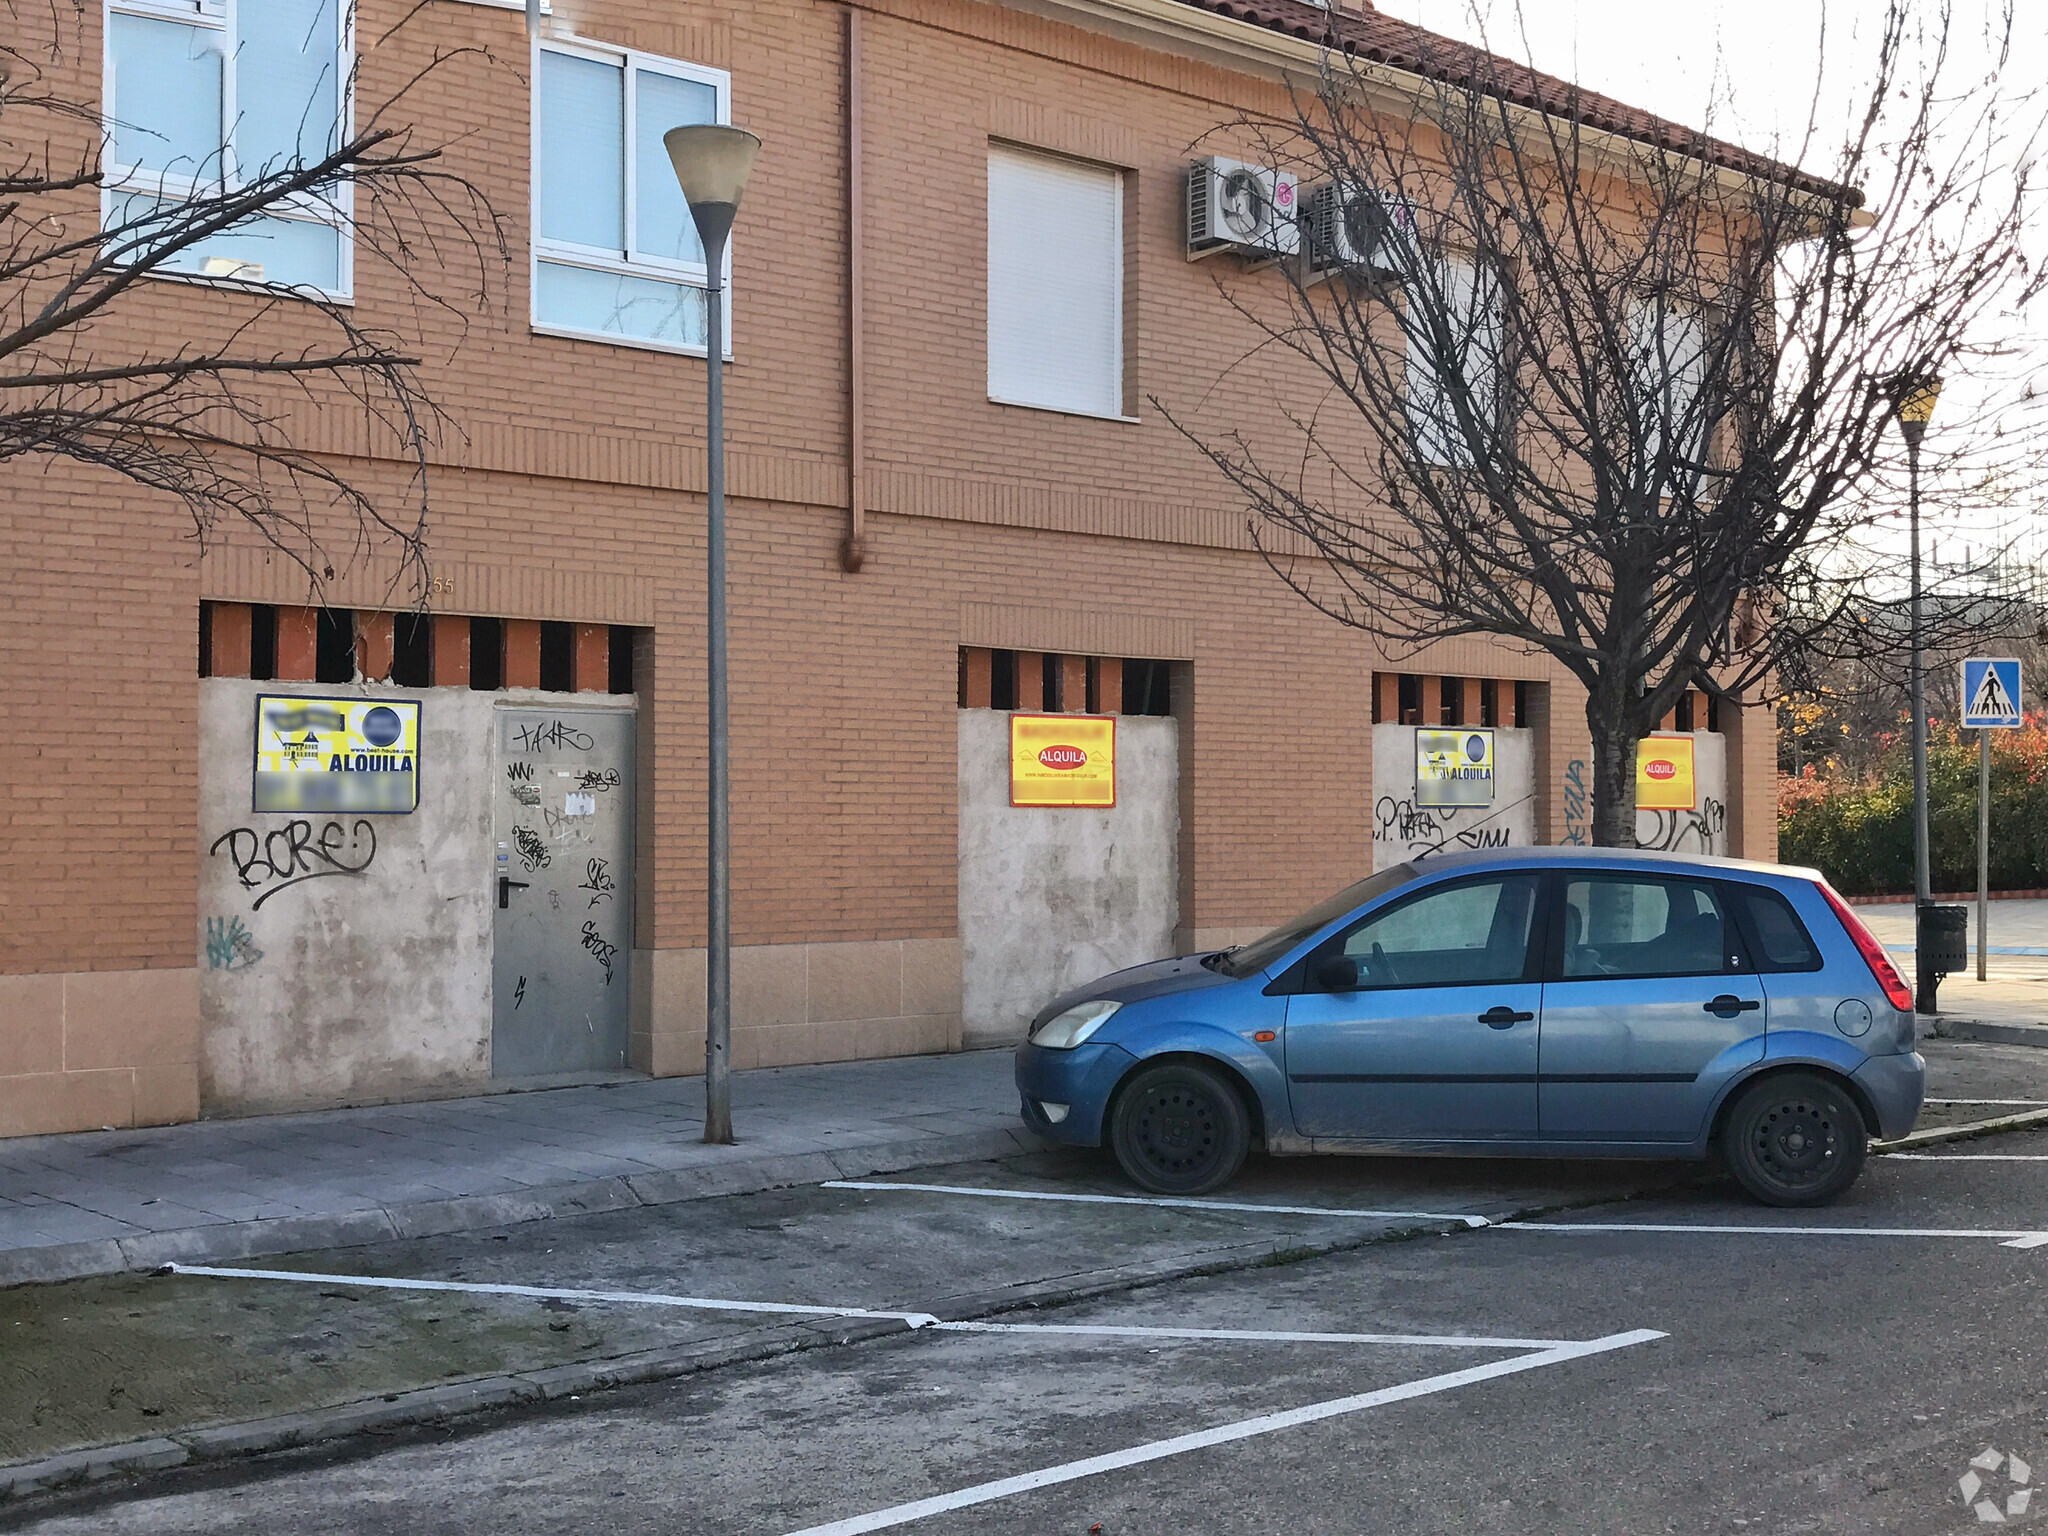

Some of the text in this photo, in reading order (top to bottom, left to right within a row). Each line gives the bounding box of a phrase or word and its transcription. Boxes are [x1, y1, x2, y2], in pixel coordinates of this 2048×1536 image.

[433, 576, 454, 594] 55
[1040, 751, 1086, 762] ALQUILA
[1645, 764, 1676, 774] ALQUILA
